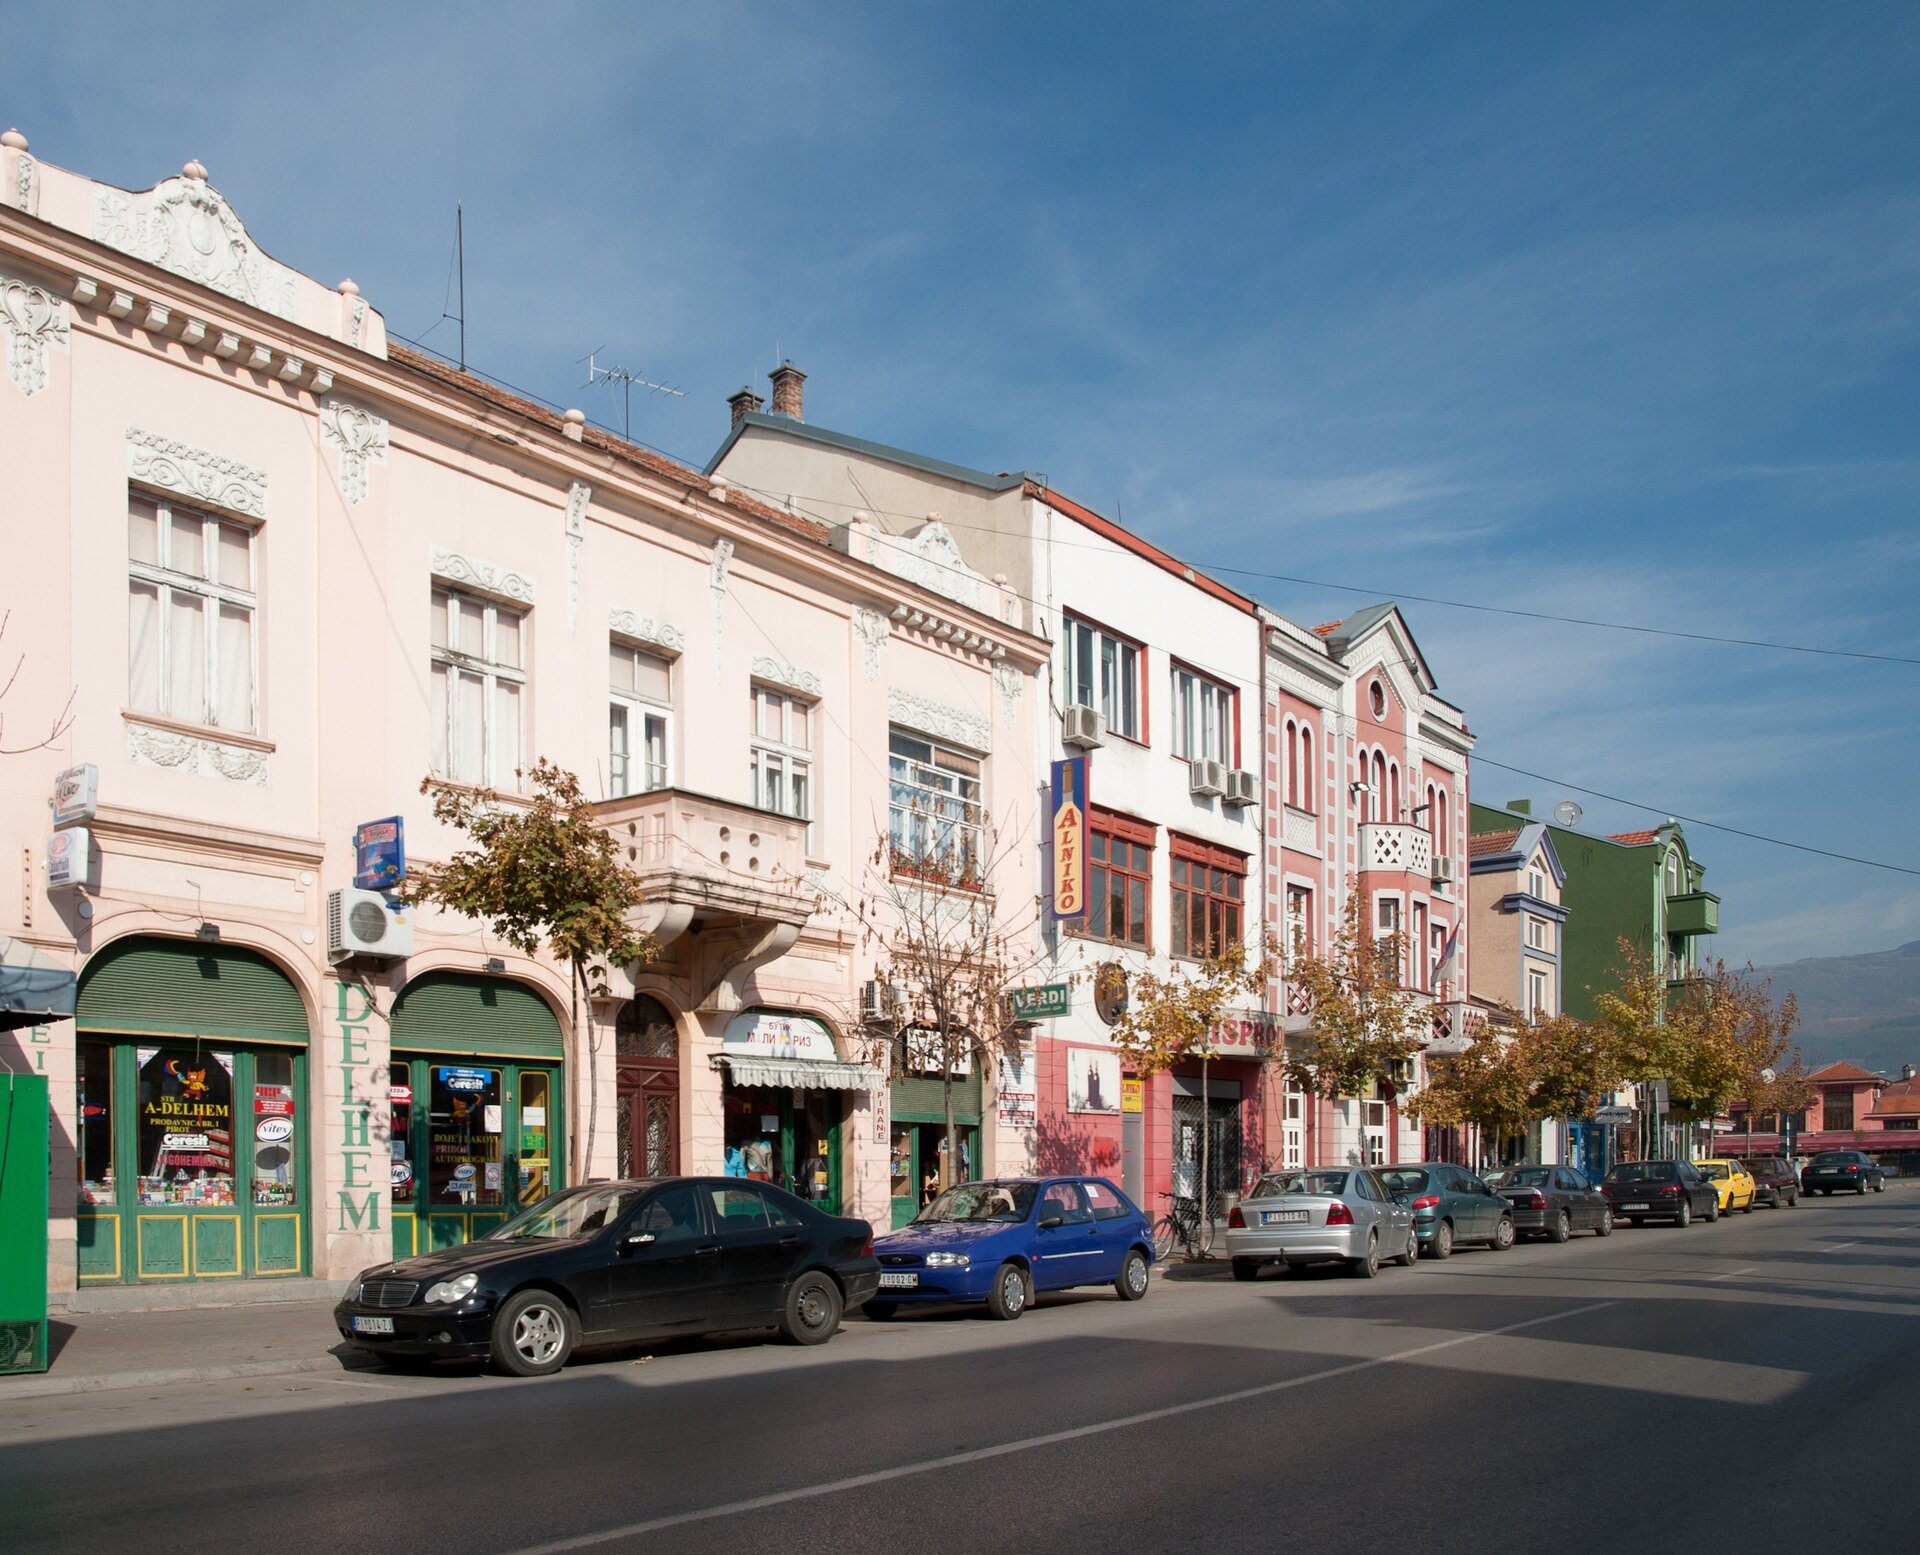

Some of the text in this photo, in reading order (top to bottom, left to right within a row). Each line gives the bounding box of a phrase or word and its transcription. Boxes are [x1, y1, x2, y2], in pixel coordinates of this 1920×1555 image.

[1057, 807, 1078, 910] ALNIKO
[1015, 989, 1065, 1008] VERDI
[768, 1021, 793, 1032] БУТИК
[144, 1101, 229, 1117] A-DELHEM
[335, 982, 382, 1231] DELHEM
[150, 1118, 201, 1127] PRODAVNICA
[262, 1123, 288, 1135] vitex
[163, 1133, 209, 1146] Ceresit
